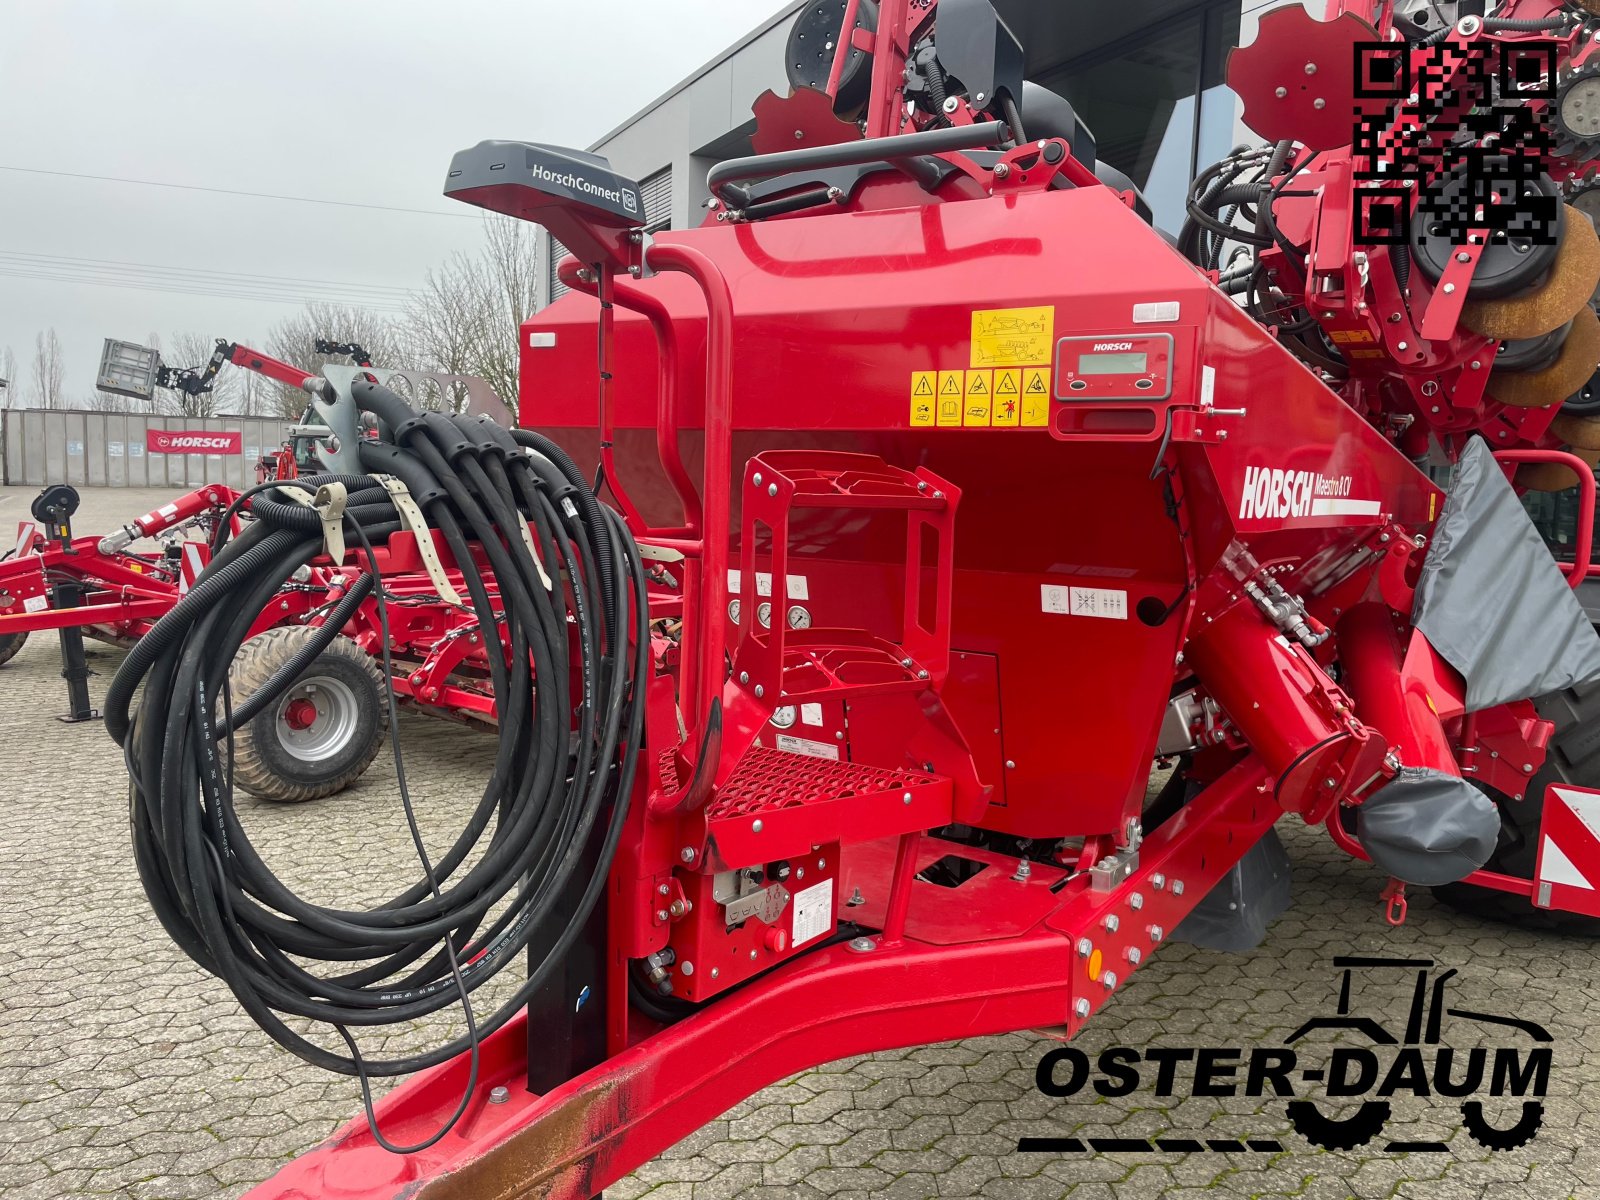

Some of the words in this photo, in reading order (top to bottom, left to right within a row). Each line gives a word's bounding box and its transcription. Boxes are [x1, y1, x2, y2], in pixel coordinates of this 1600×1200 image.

[532, 164, 621, 203] HorschConnect
[1093, 342, 1133, 352] HORSCH
[171, 437, 231, 448] HORSCH
[1239, 466, 1314, 519] HORSCH
[1314, 473, 1338, 496] Maestro
[1338, 475, 1344, 496] 8
[1343, 476, 1352, 496] CV
